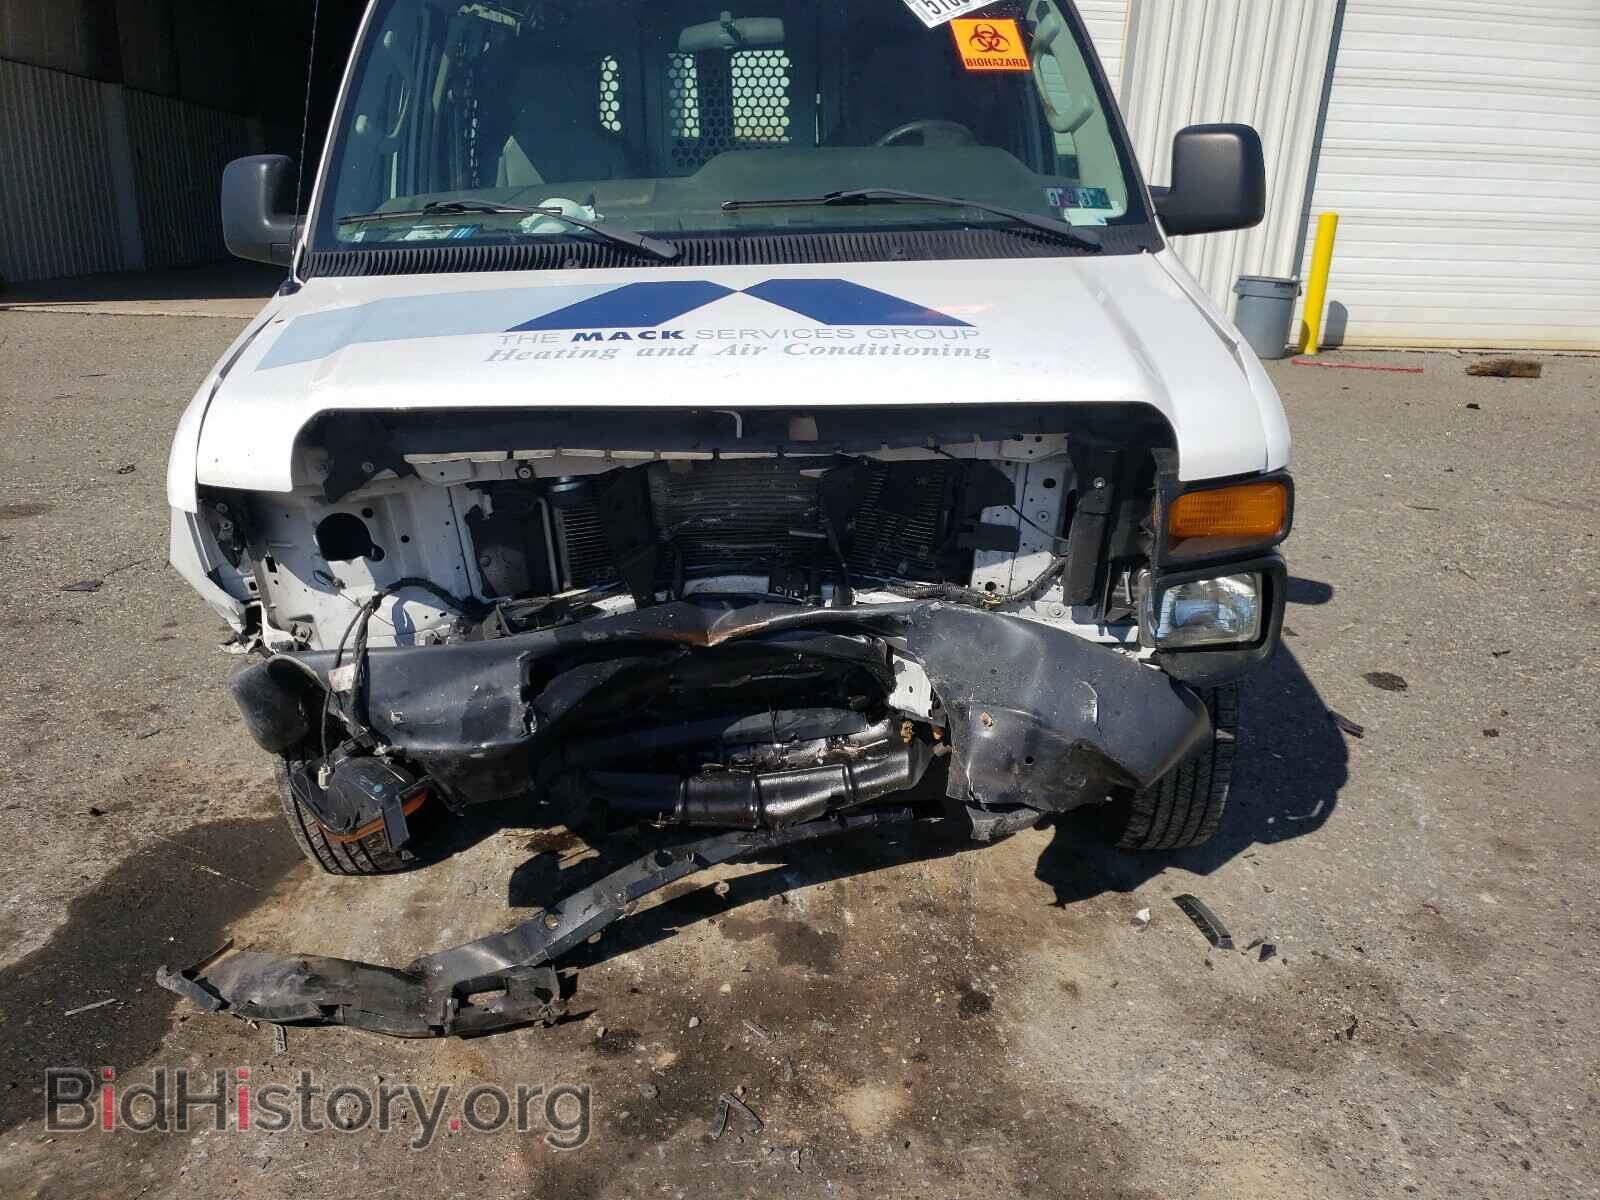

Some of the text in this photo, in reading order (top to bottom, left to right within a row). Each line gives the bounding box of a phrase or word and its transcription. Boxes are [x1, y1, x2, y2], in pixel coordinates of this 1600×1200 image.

[966, 58, 1028, 67] BIOHAZARD
[499, 328, 980, 345] THE MACK SERVICES GROUP
[485, 343, 992, 362] Heating and Air Conditioning
